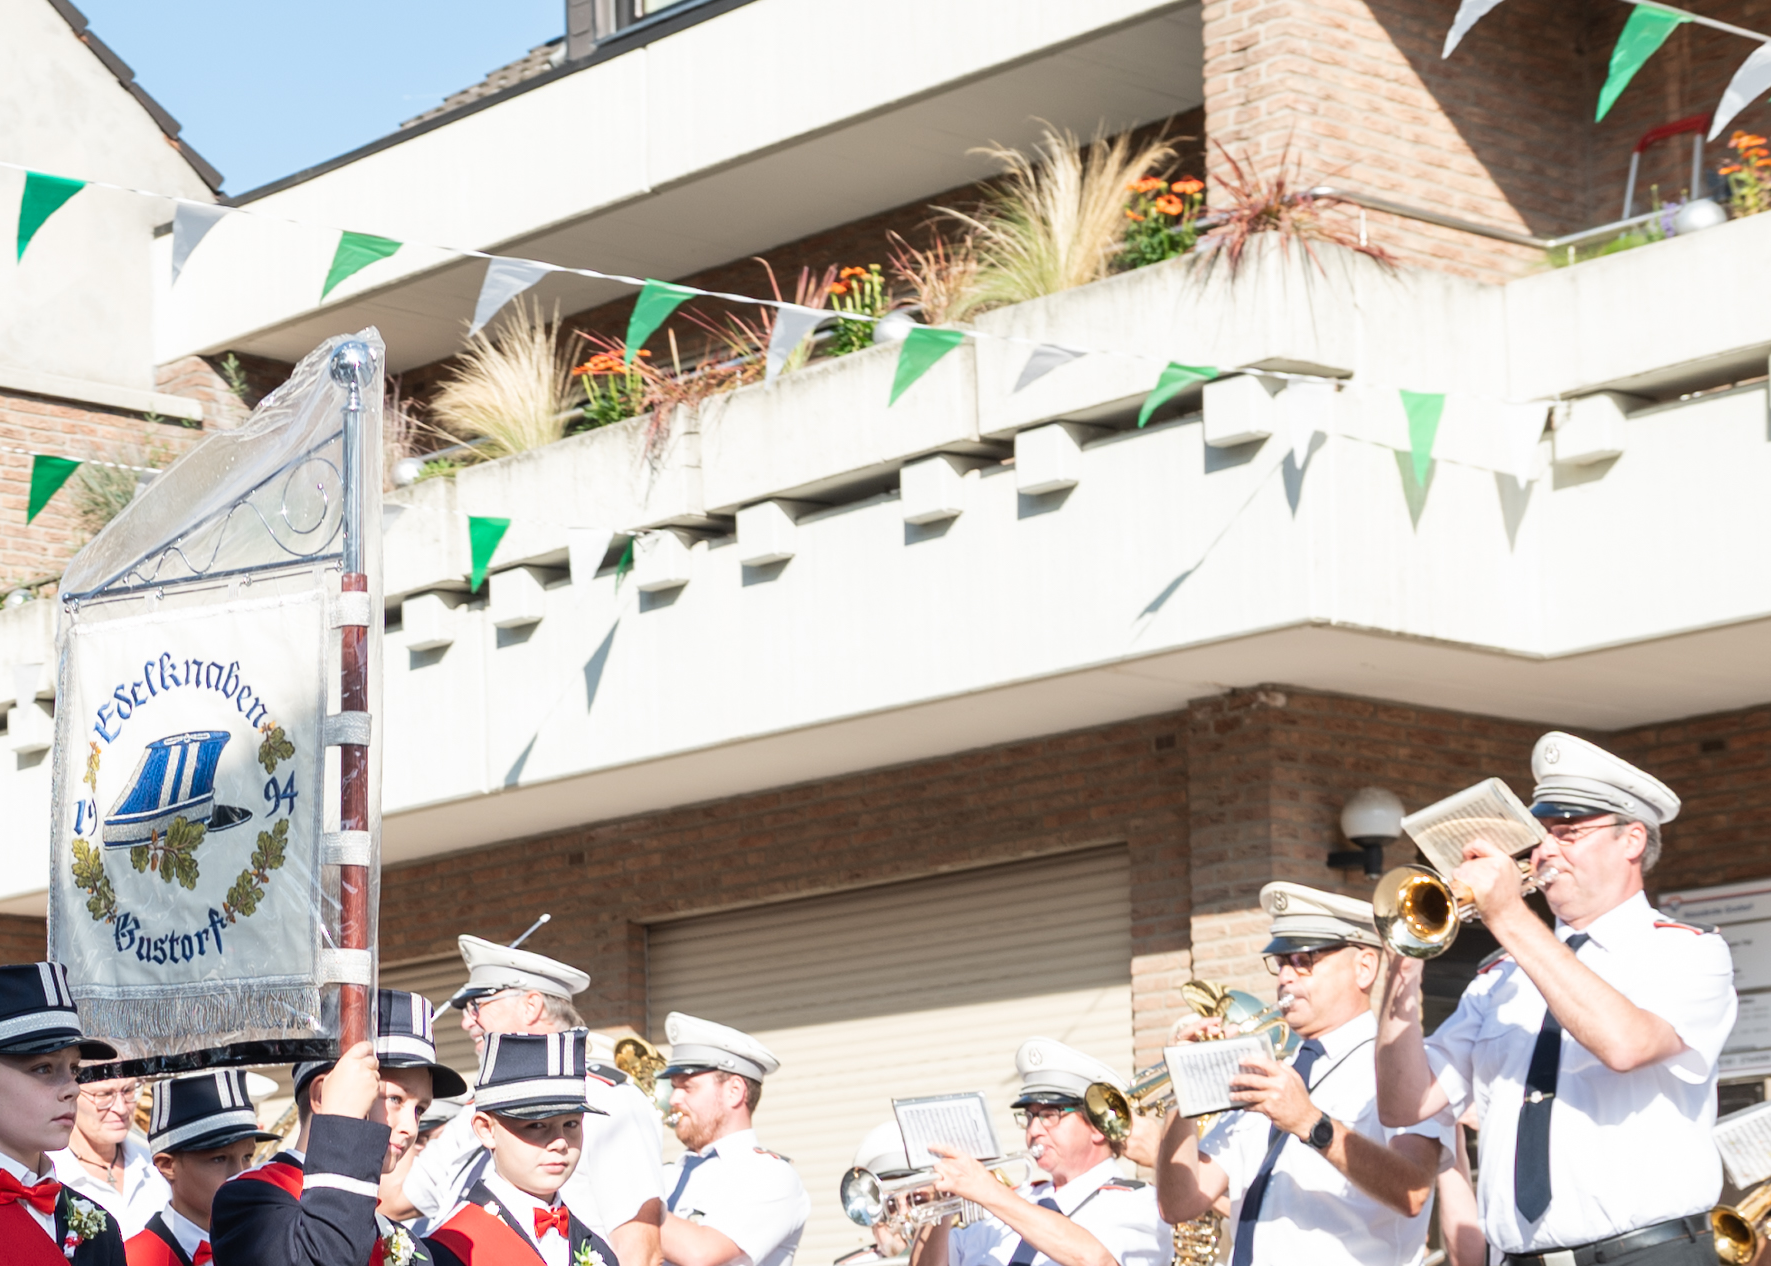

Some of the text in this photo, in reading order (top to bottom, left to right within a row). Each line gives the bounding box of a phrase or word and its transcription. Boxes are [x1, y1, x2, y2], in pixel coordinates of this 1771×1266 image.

[92, 651, 269, 745] Edelknaben
[72, 770, 300, 837] 19 94
[113, 907, 227, 965] Gustorf
